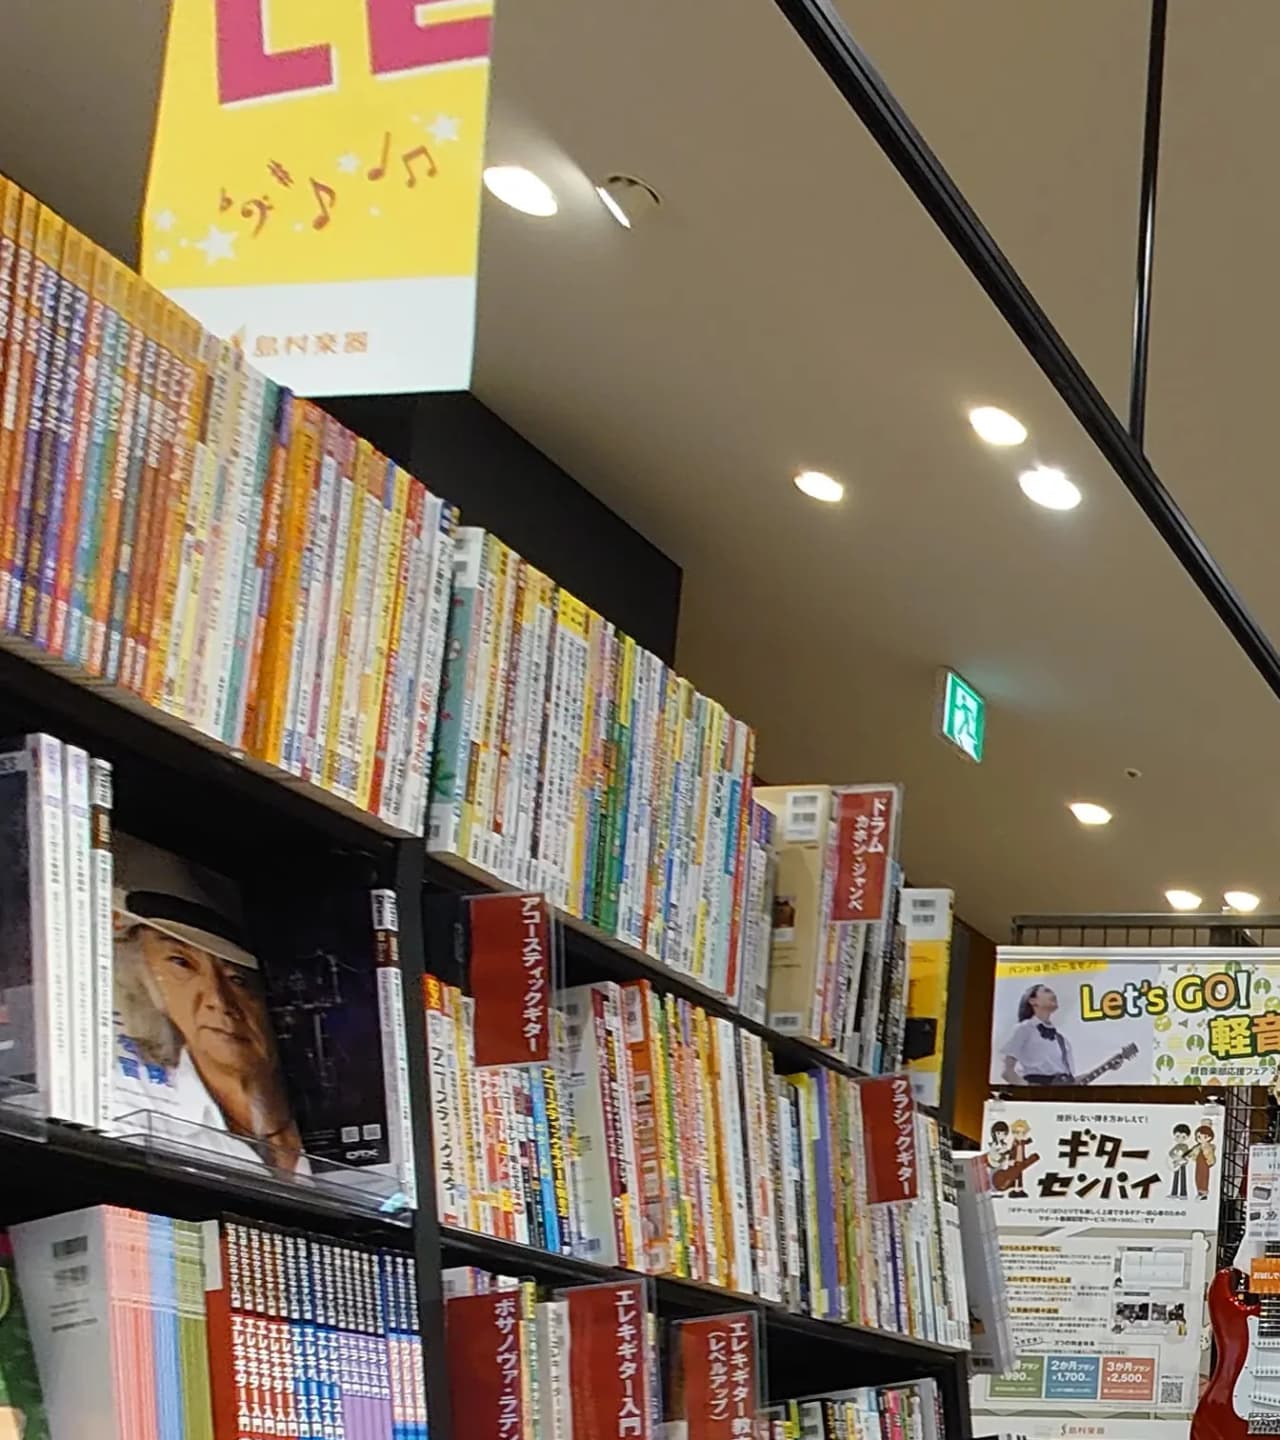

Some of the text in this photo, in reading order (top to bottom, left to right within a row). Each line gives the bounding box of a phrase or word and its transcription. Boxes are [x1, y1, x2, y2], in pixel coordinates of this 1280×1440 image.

[254, 331, 370, 359] 島村楽器
[866, 797, 886, 855] ドラム
[520, 896, 547, 1053] アコースティックギター
[1081, 979, 1167, 1021] Let's
[891, 1078, 912, 1196] クラシックギター
[1058, 1128, 1150, 1169] ギター
[1037, 1171, 1162, 1200] センパイ
[615, 1289, 642, 1439] エレキギター入門
